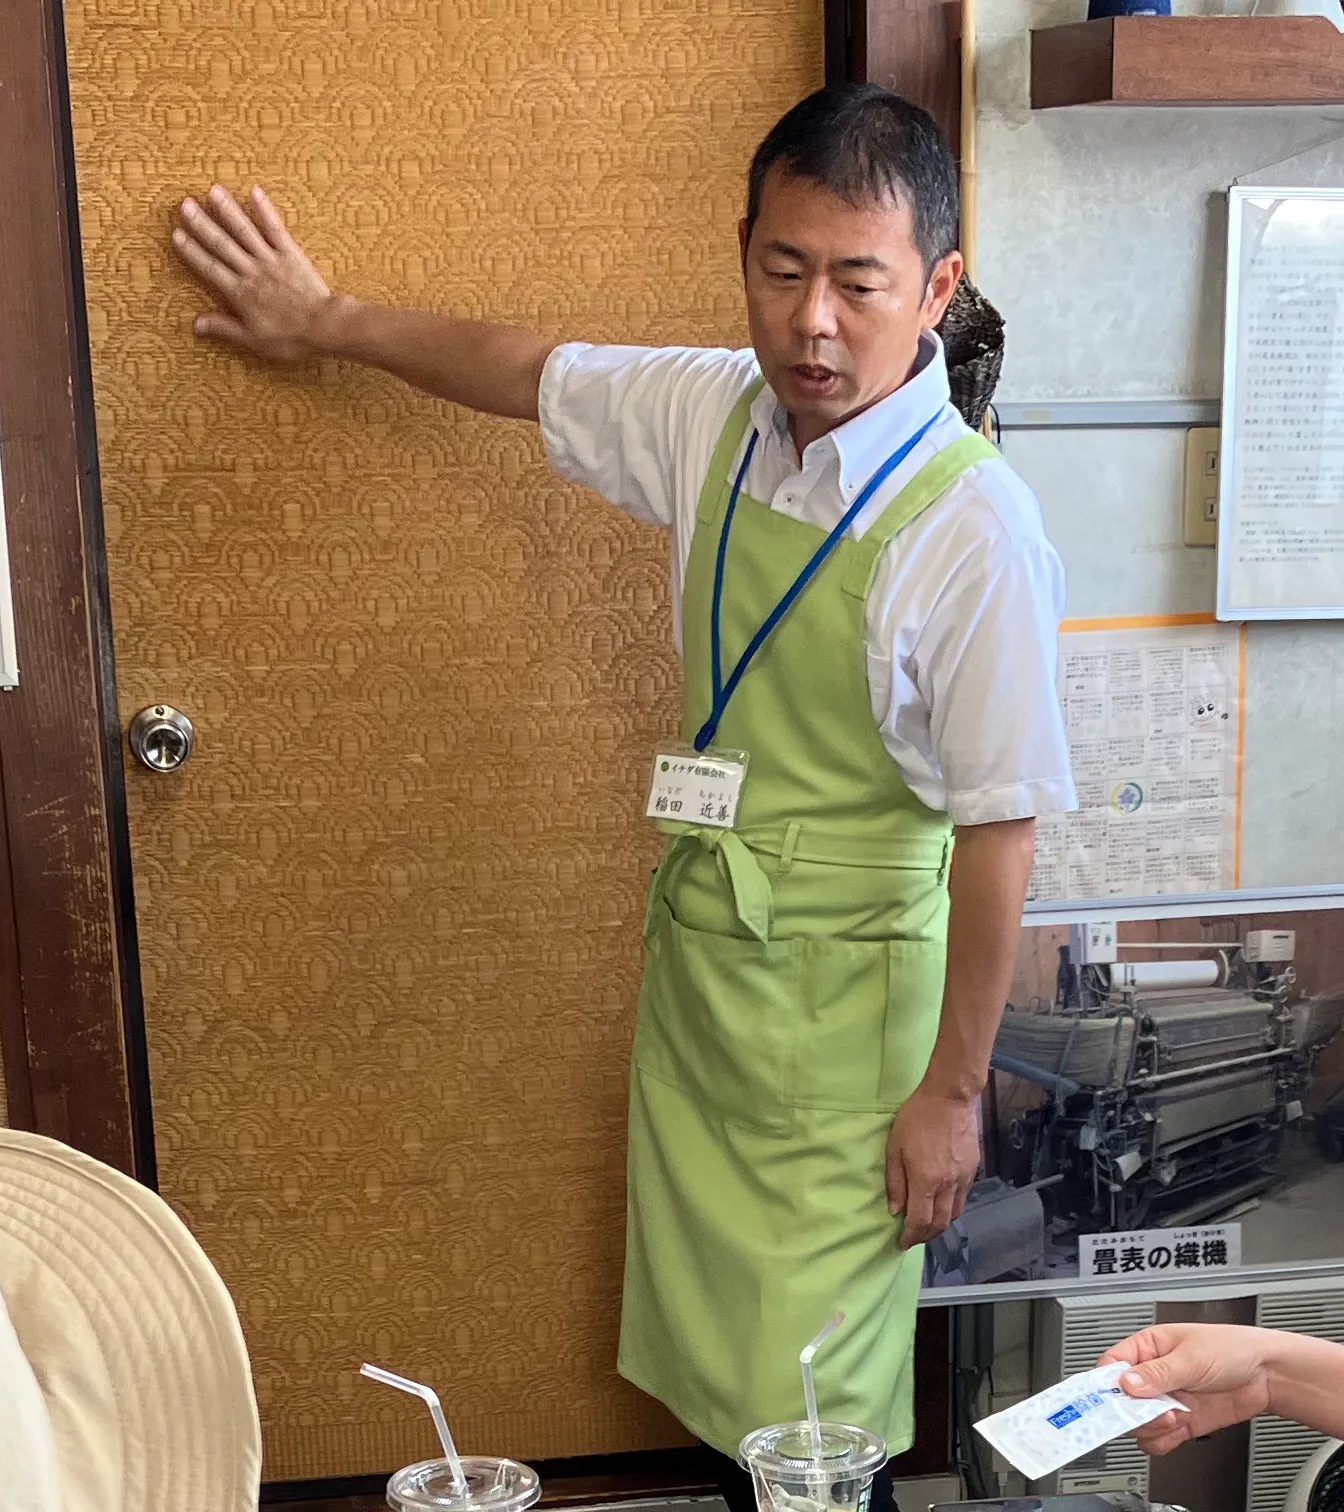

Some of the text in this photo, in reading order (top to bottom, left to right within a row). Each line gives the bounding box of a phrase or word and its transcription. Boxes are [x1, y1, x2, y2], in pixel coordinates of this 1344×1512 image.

[656, 796, 683, 812] 稲田
[1093, 1240, 1228, 1276] 畳表の織機
